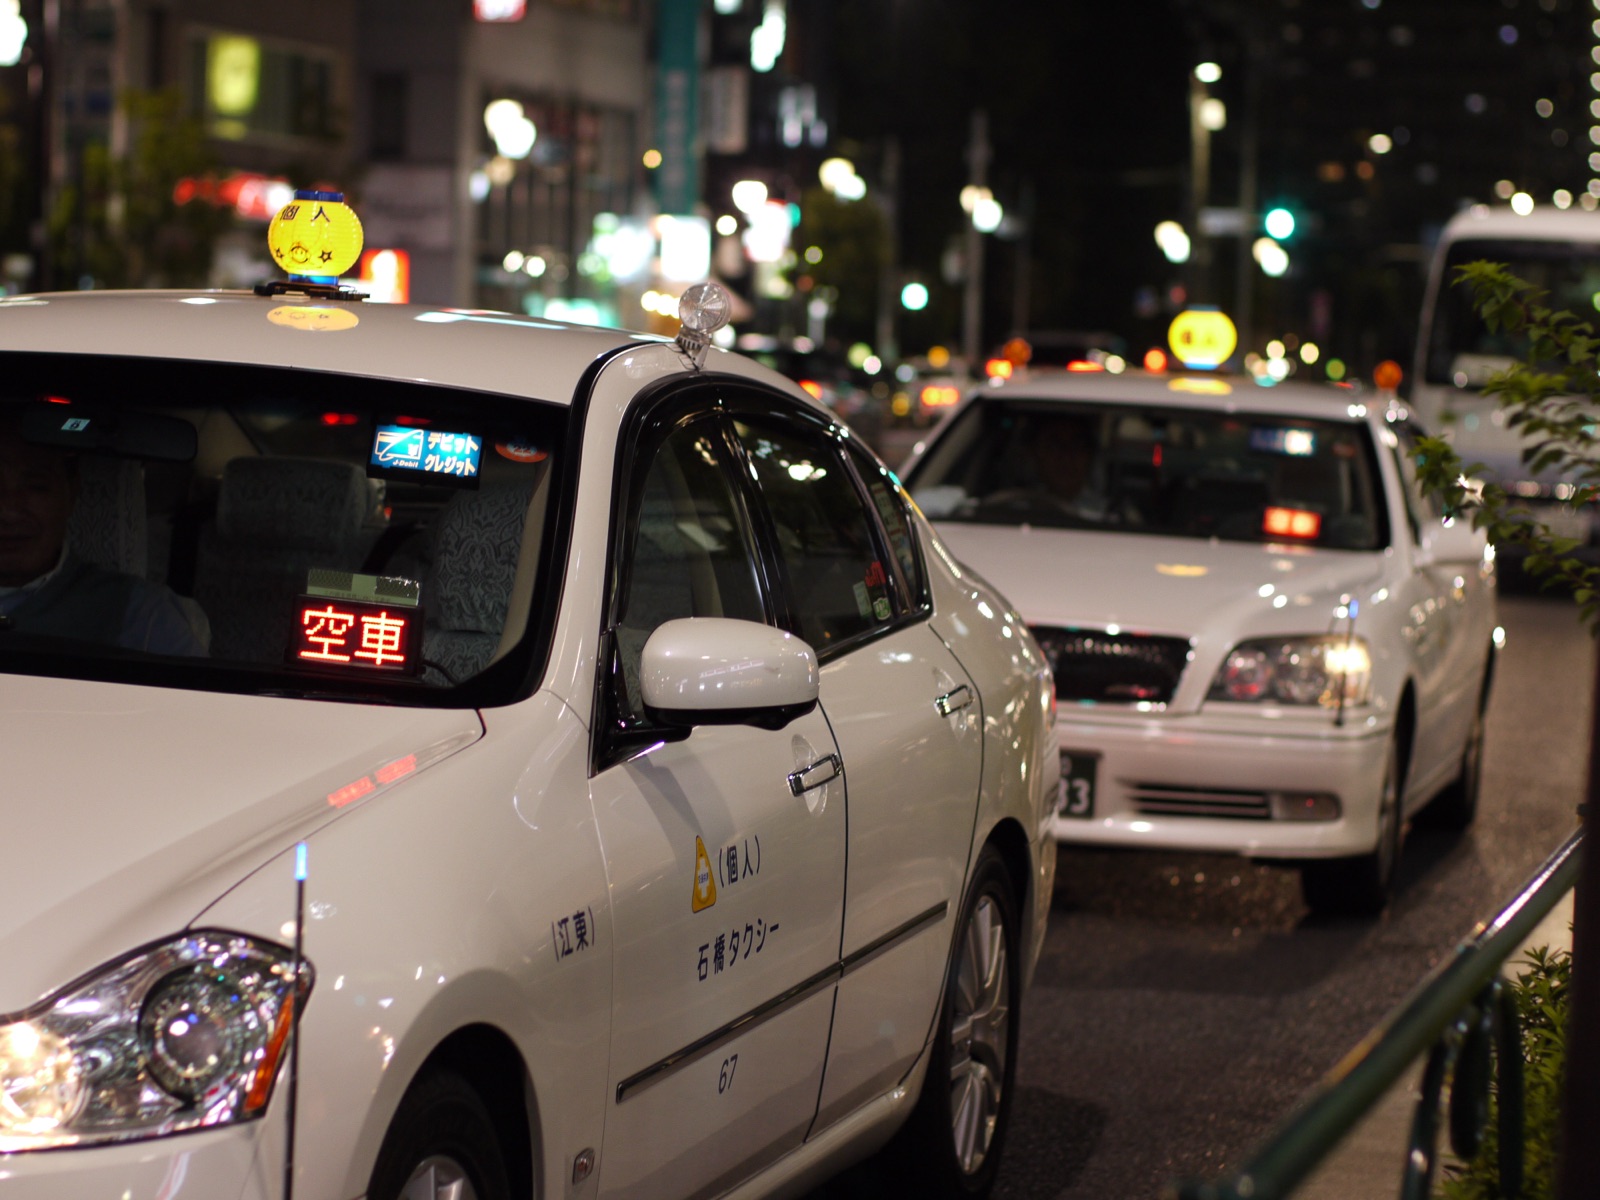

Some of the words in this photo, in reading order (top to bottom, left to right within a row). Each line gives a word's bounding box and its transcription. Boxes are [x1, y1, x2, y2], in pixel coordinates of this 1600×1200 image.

[280, 205, 331, 222] 個人
[424, 454, 476, 476] クレジット
[427, 432, 480, 455] デビット
[300, 605, 405, 665] 空車
[718, 834, 761, 889] (個人)
[551, 905, 595, 963] (江東)
[696, 917, 780, 983] 石橋タクシー
[718, 1053, 739, 1096] 67
